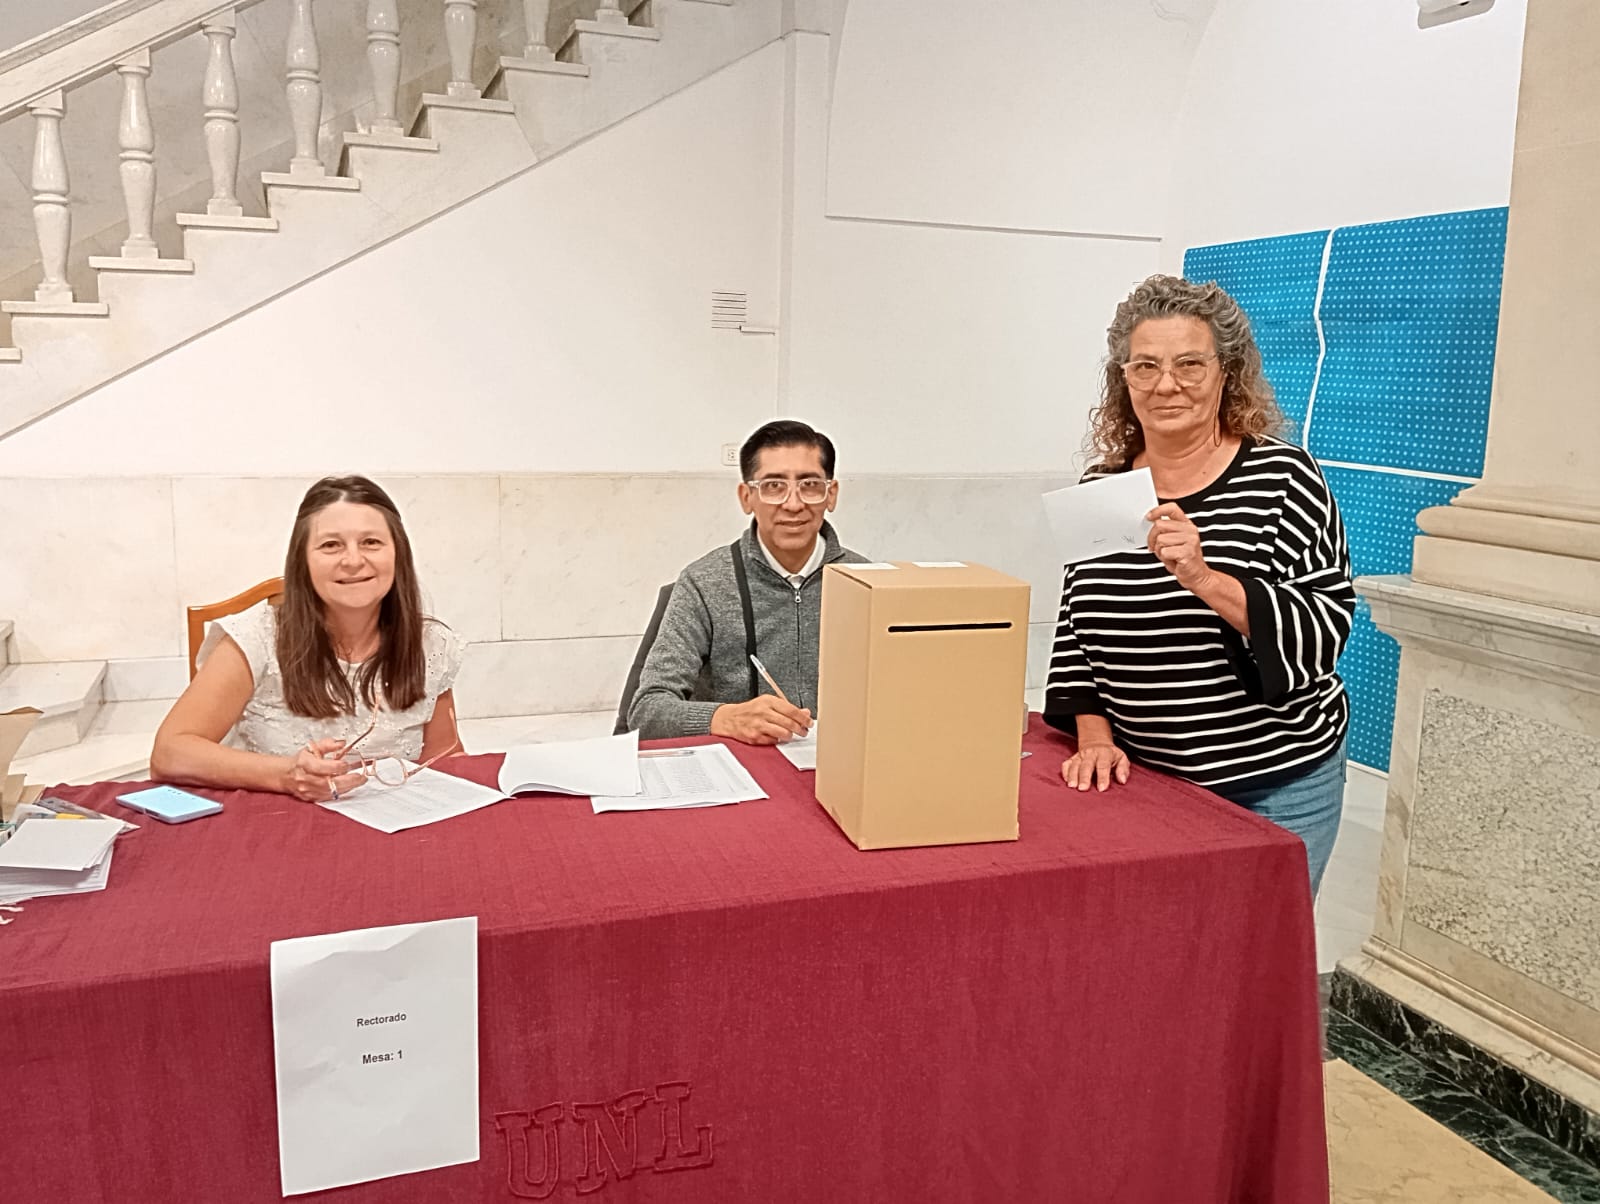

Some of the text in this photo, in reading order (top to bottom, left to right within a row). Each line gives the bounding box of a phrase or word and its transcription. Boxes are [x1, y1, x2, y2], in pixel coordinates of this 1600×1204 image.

[356, 1012, 407, 1027] Rectorado
[362, 1049, 403, 1065] Mesa: 1
[495, 1081, 713, 1198] UNL
